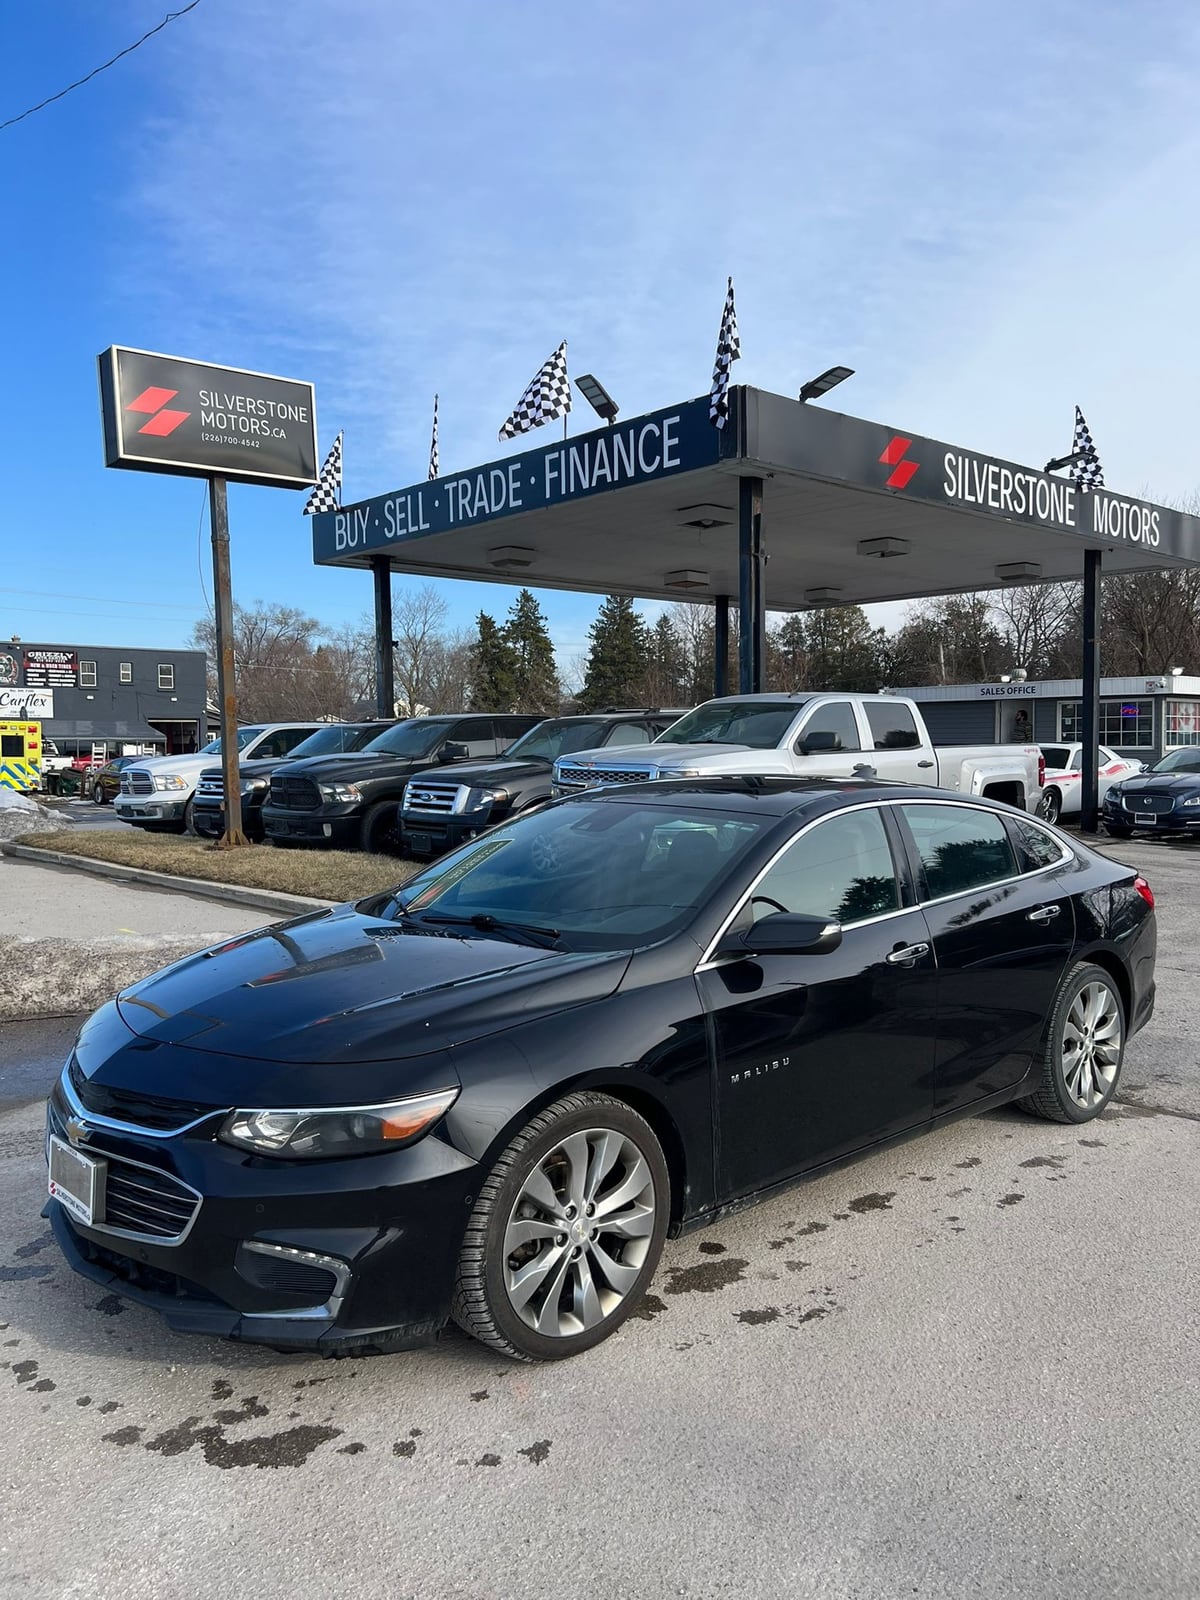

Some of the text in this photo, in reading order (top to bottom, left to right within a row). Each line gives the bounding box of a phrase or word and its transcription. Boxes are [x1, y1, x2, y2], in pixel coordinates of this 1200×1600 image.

[199, 390, 308, 423] SILVERSTONE
[201, 410, 287, 439] MOTORS.CA
[335, 416, 681, 550] BUY SELL TRADE FINANCE
[943, 452, 1160, 547] SILVERSTONE MOTORS
[0, 692, 47, 707] Carflex
[980, 686, 1036, 696] SALES OFFICE
[731, 1057, 790, 1083] MALIBU
